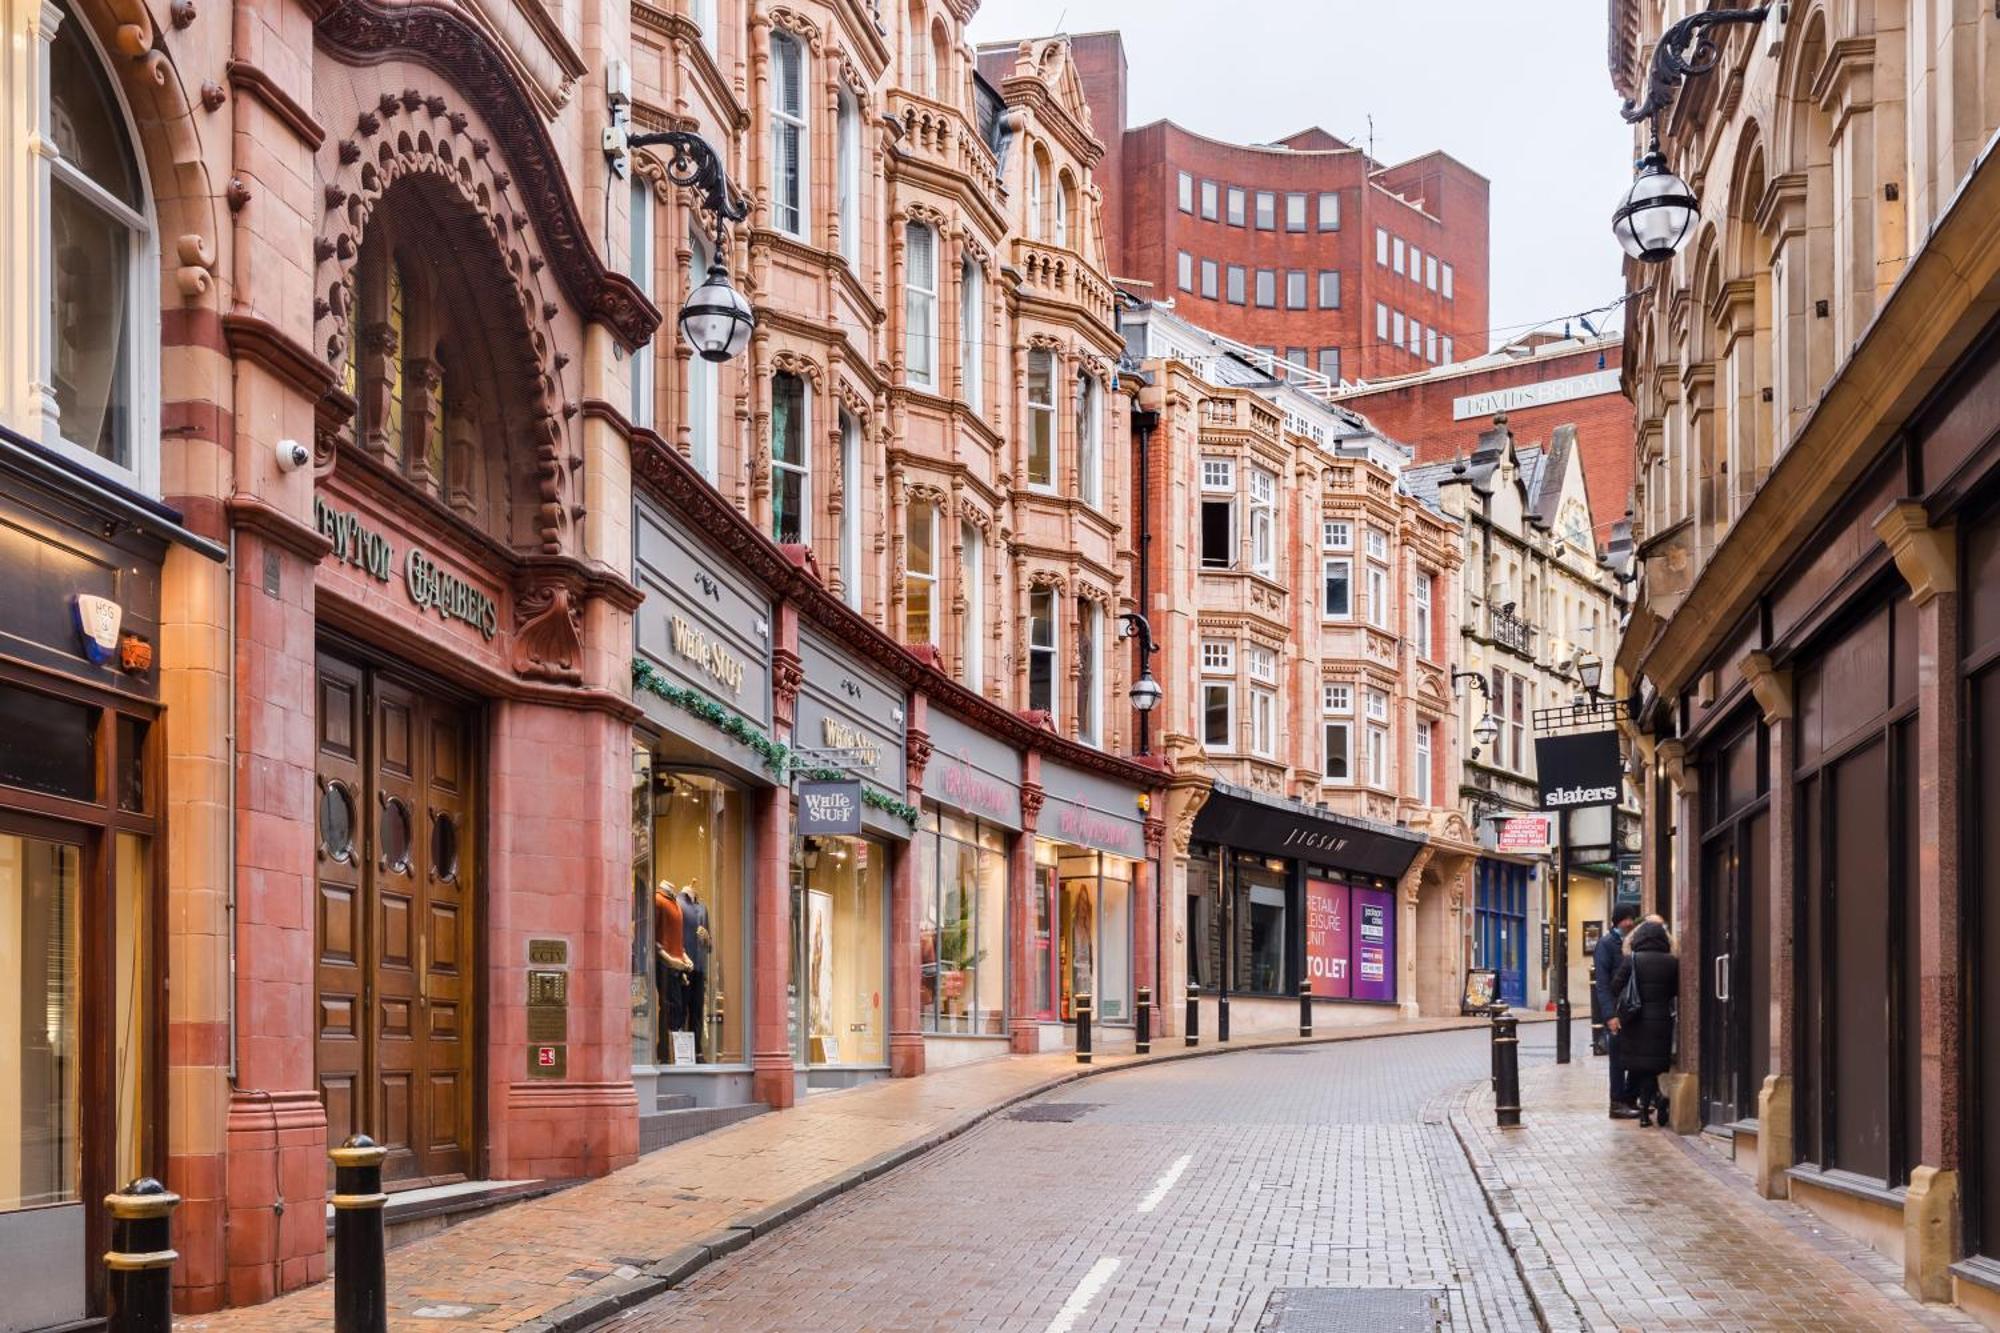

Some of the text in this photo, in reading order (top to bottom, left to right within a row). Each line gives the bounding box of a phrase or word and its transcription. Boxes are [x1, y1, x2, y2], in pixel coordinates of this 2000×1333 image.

[404, 547, 497, 641] CHAMBERS
[1546, 785, 1617, 806] slaters
[1283, 828, 1349, 853] JIGSAW
[1308, 931, 1326, 946] NIT
[531, 951, 565, 962] CCTV
[1307, 956, 1347, 979] TO LET
